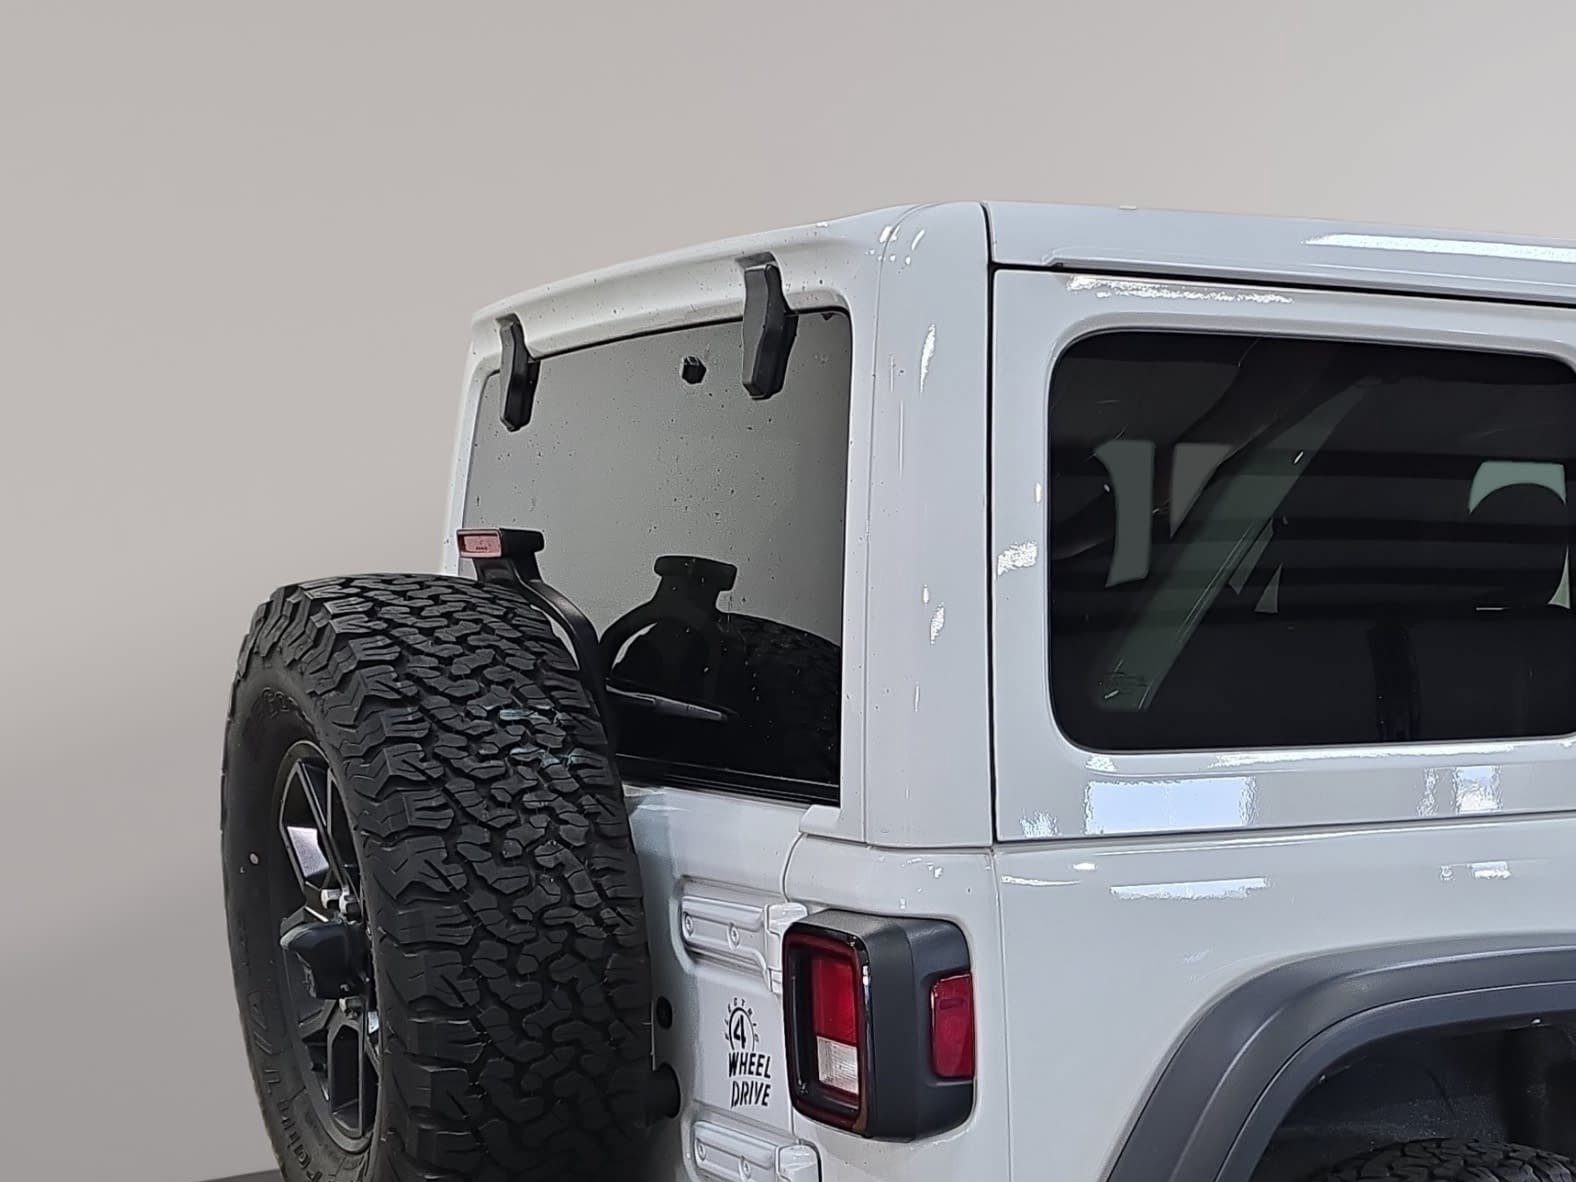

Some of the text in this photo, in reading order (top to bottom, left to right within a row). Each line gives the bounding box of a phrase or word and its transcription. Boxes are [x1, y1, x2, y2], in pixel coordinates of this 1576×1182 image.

[733, 1014, 747, 1050] 4
[728, 1051, 772, 1079] WHEEL
[730, 1080, 772, 1109] DRIVE
